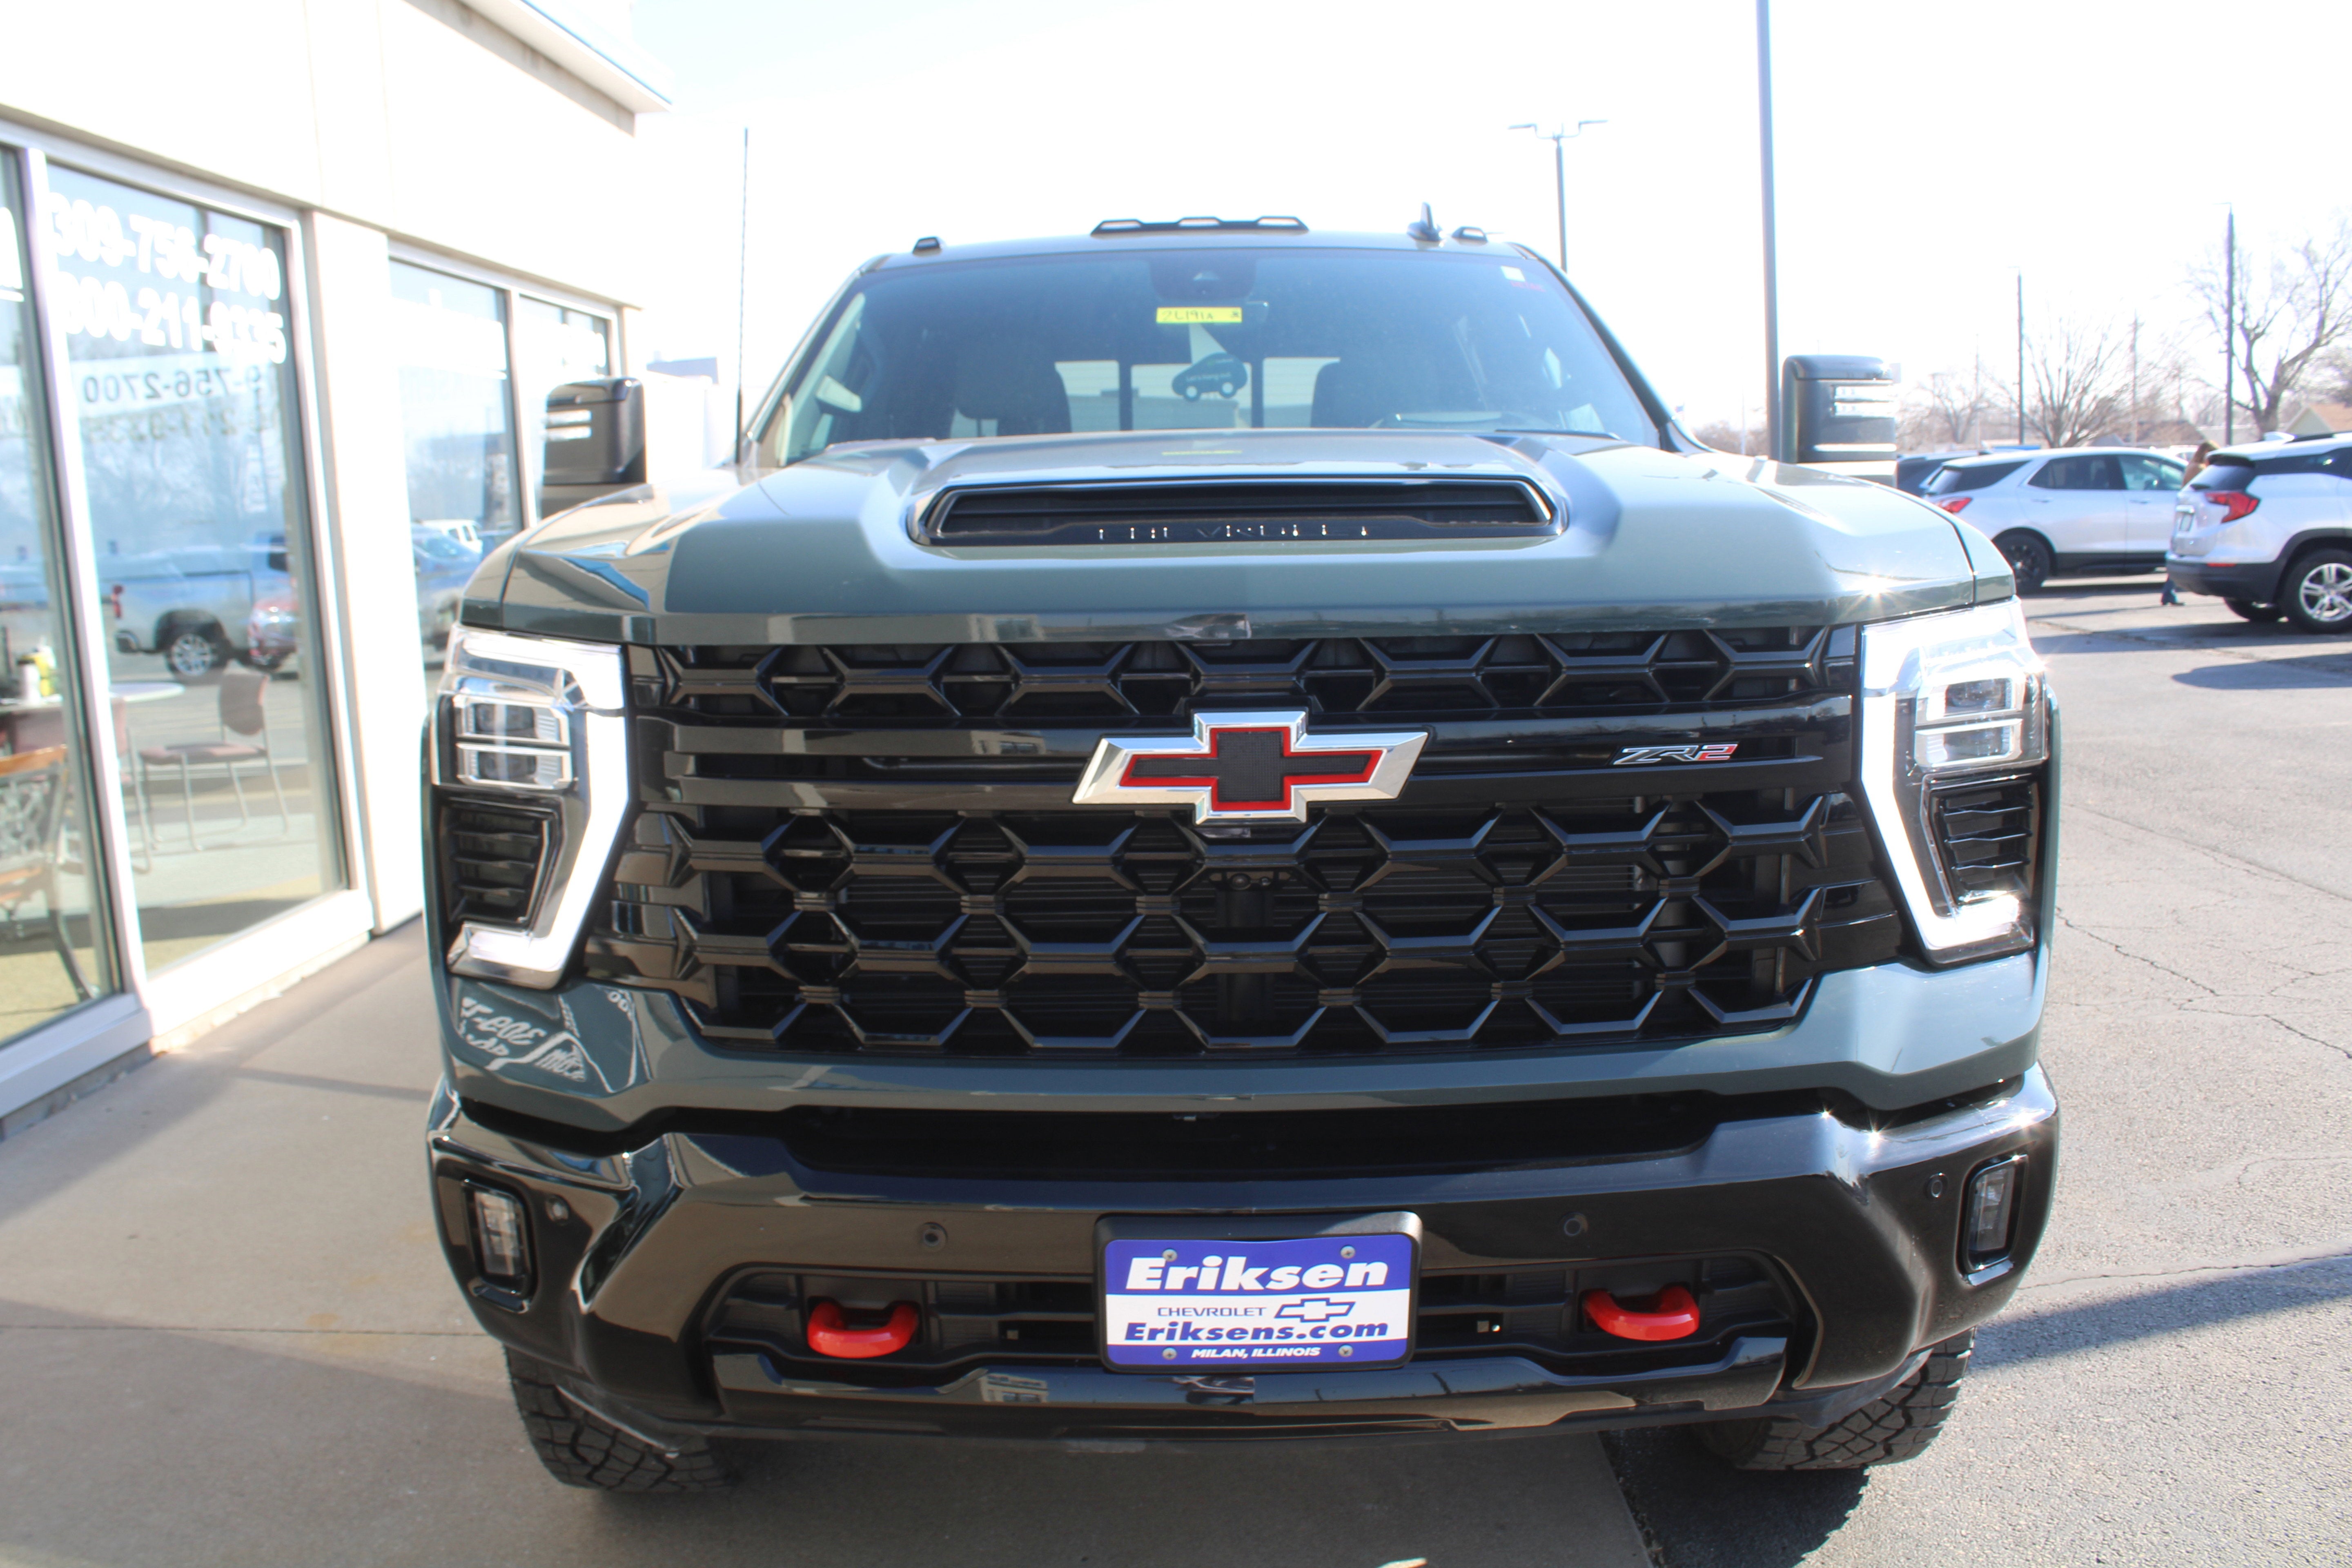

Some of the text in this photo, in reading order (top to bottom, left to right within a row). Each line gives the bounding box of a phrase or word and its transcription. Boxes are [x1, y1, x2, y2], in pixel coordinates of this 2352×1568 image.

[1613, 743, 1738, 765] ZR2
[1126, 1255, 1388, 1291] Eriksen
[1157, 1307, 1267, 1317] CHEVROLET
[1124, 1321, 1388, 1341] Eriksens.com
[1191, 1346, 1321, 1359] MILAN, ILLINOIS
